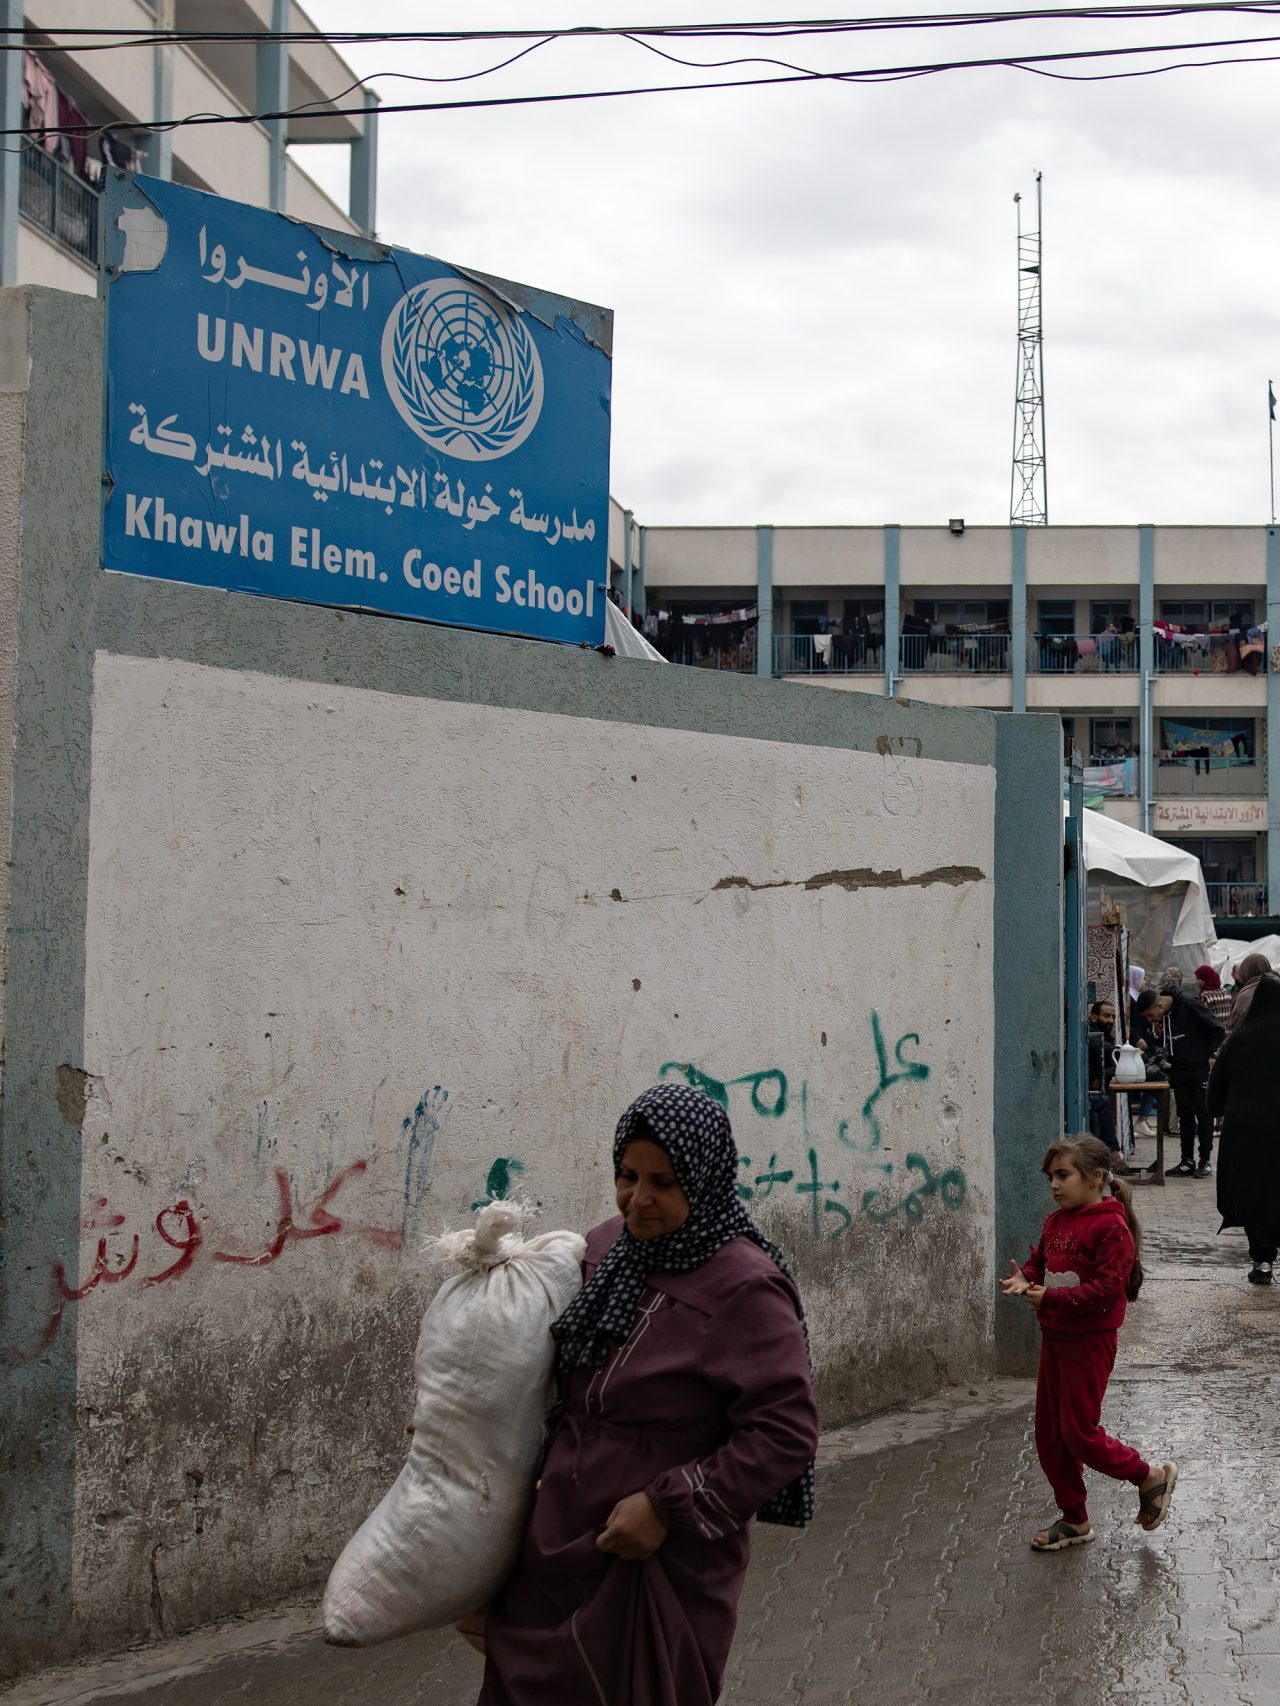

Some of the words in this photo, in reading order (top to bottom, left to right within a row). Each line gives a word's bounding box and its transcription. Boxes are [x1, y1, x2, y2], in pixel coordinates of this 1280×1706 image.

[197, 313, 370, 400] UNRWA
[128, 402, 282, 481] المشتركة
[292, 441, 426, 515] الابتدائية
[433, 471, 501, 529] خولة
[509, 488, 596, 545] مدرسة
[125, 494, 274, 562] Khawla
[291, 527, 389, 583] Elem.
[402, 548, 482, 599] Coed
[494, 565, 594, 618] School
